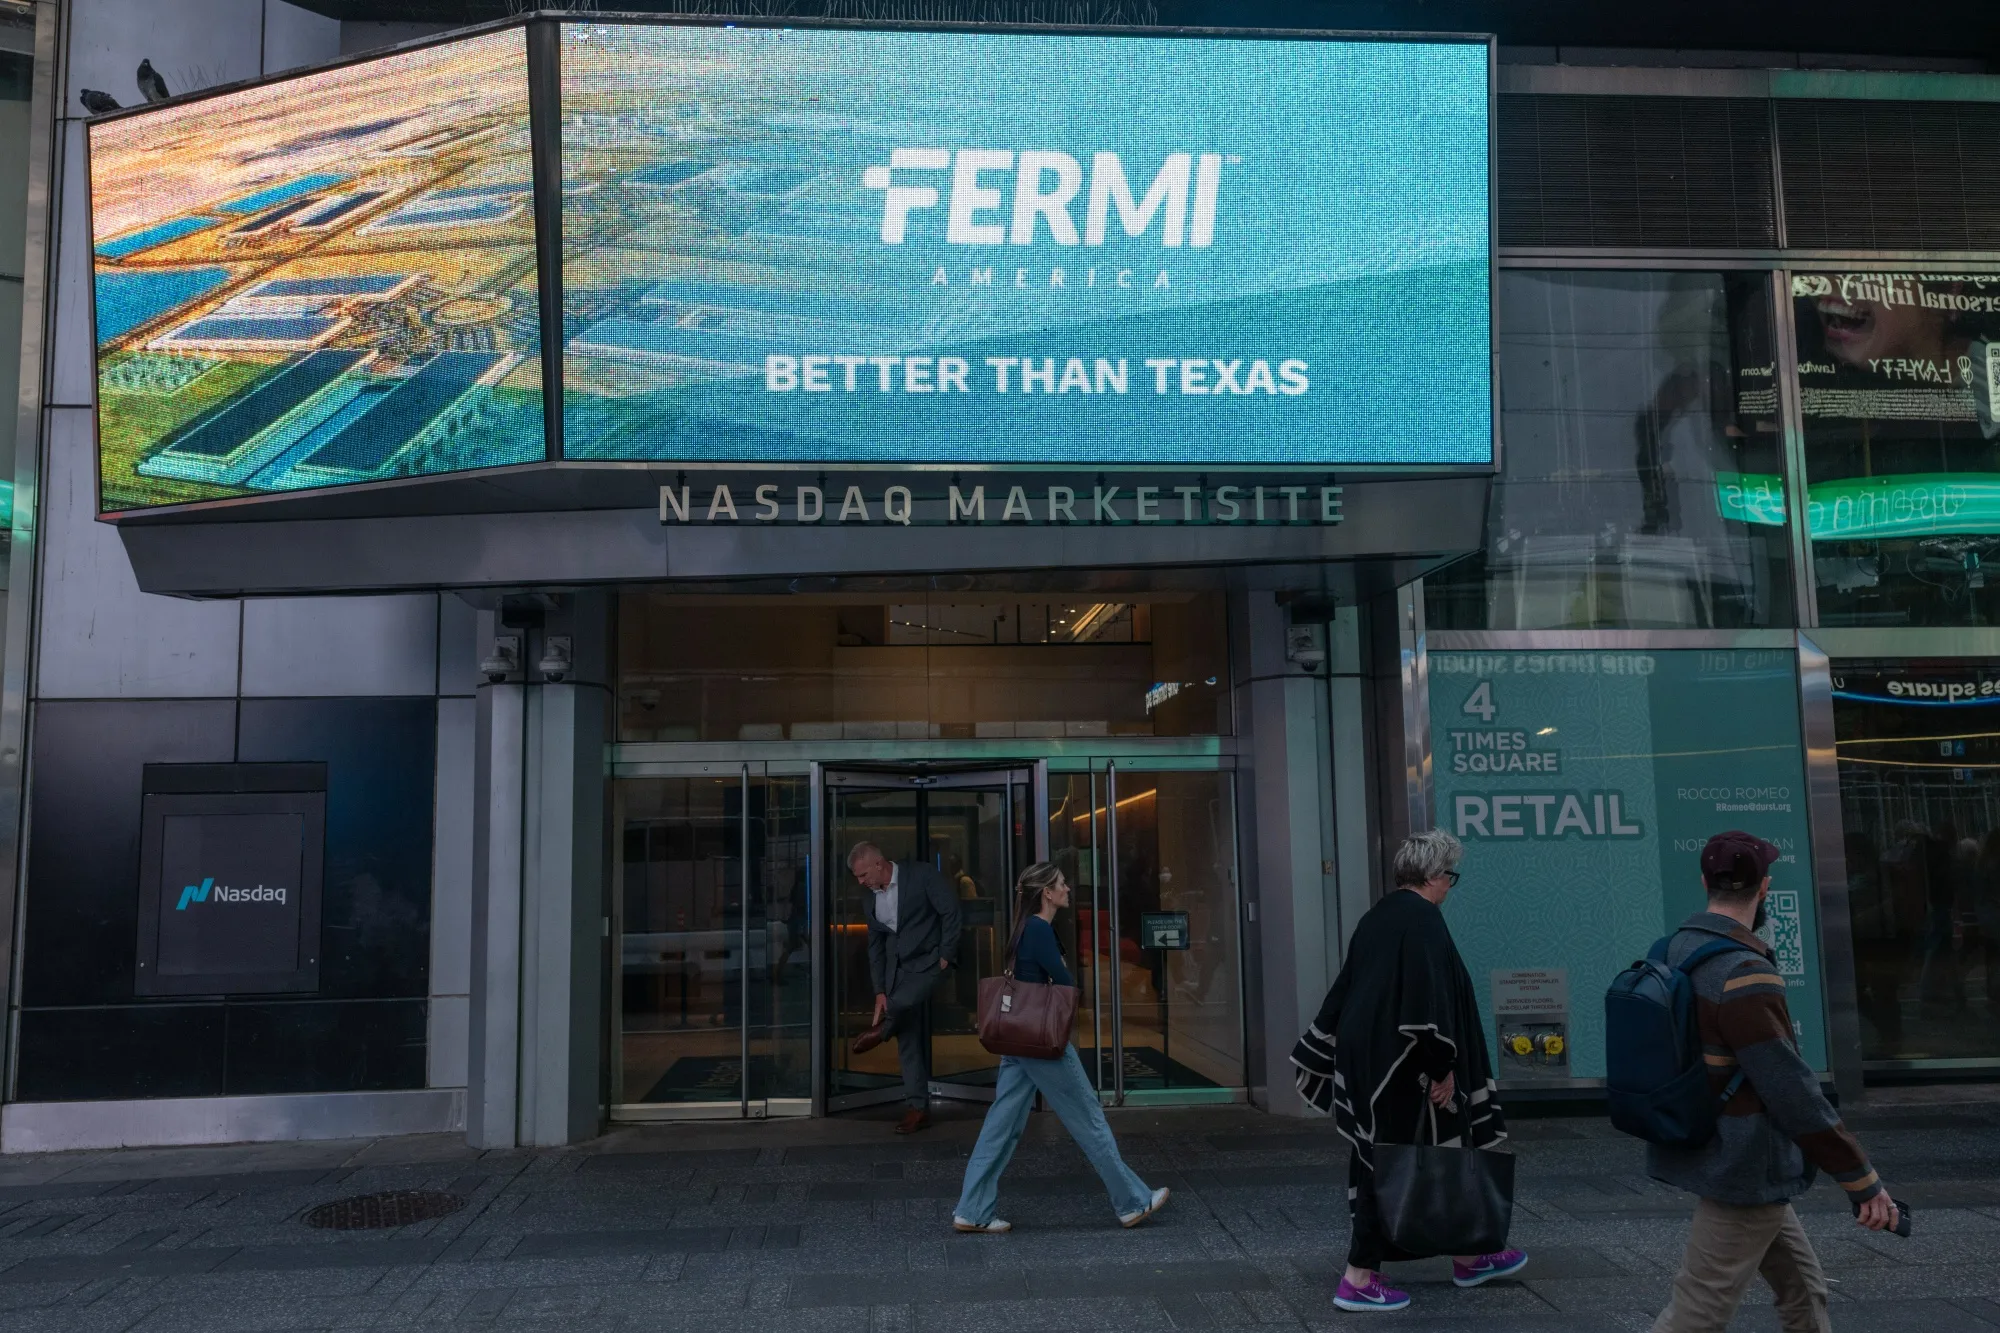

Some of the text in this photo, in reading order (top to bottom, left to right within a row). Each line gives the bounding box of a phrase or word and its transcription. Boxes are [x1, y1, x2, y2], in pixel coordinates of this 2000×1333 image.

[863, 147, 1222, 248] FERMI
[931, 266, 1172, 290] AMERICA
[764, 353, 1310, 397] BETTER THAN TEXAS
[658, 484, 1346, 526] NASDAQ MARKETSITE
[1463, 682, 1497, 721] 4
[1451, 732, 1527, 751] TIMES
[1453, 753, 1558, 773] SQUARE
[1677, 787, 1790, 801] ROCCO ROMEO
[1455, 795, 1640, 837] RETAIL
[214, 884, 287, 906] Nasdaq
[1788, 978, 1805, 988] info
